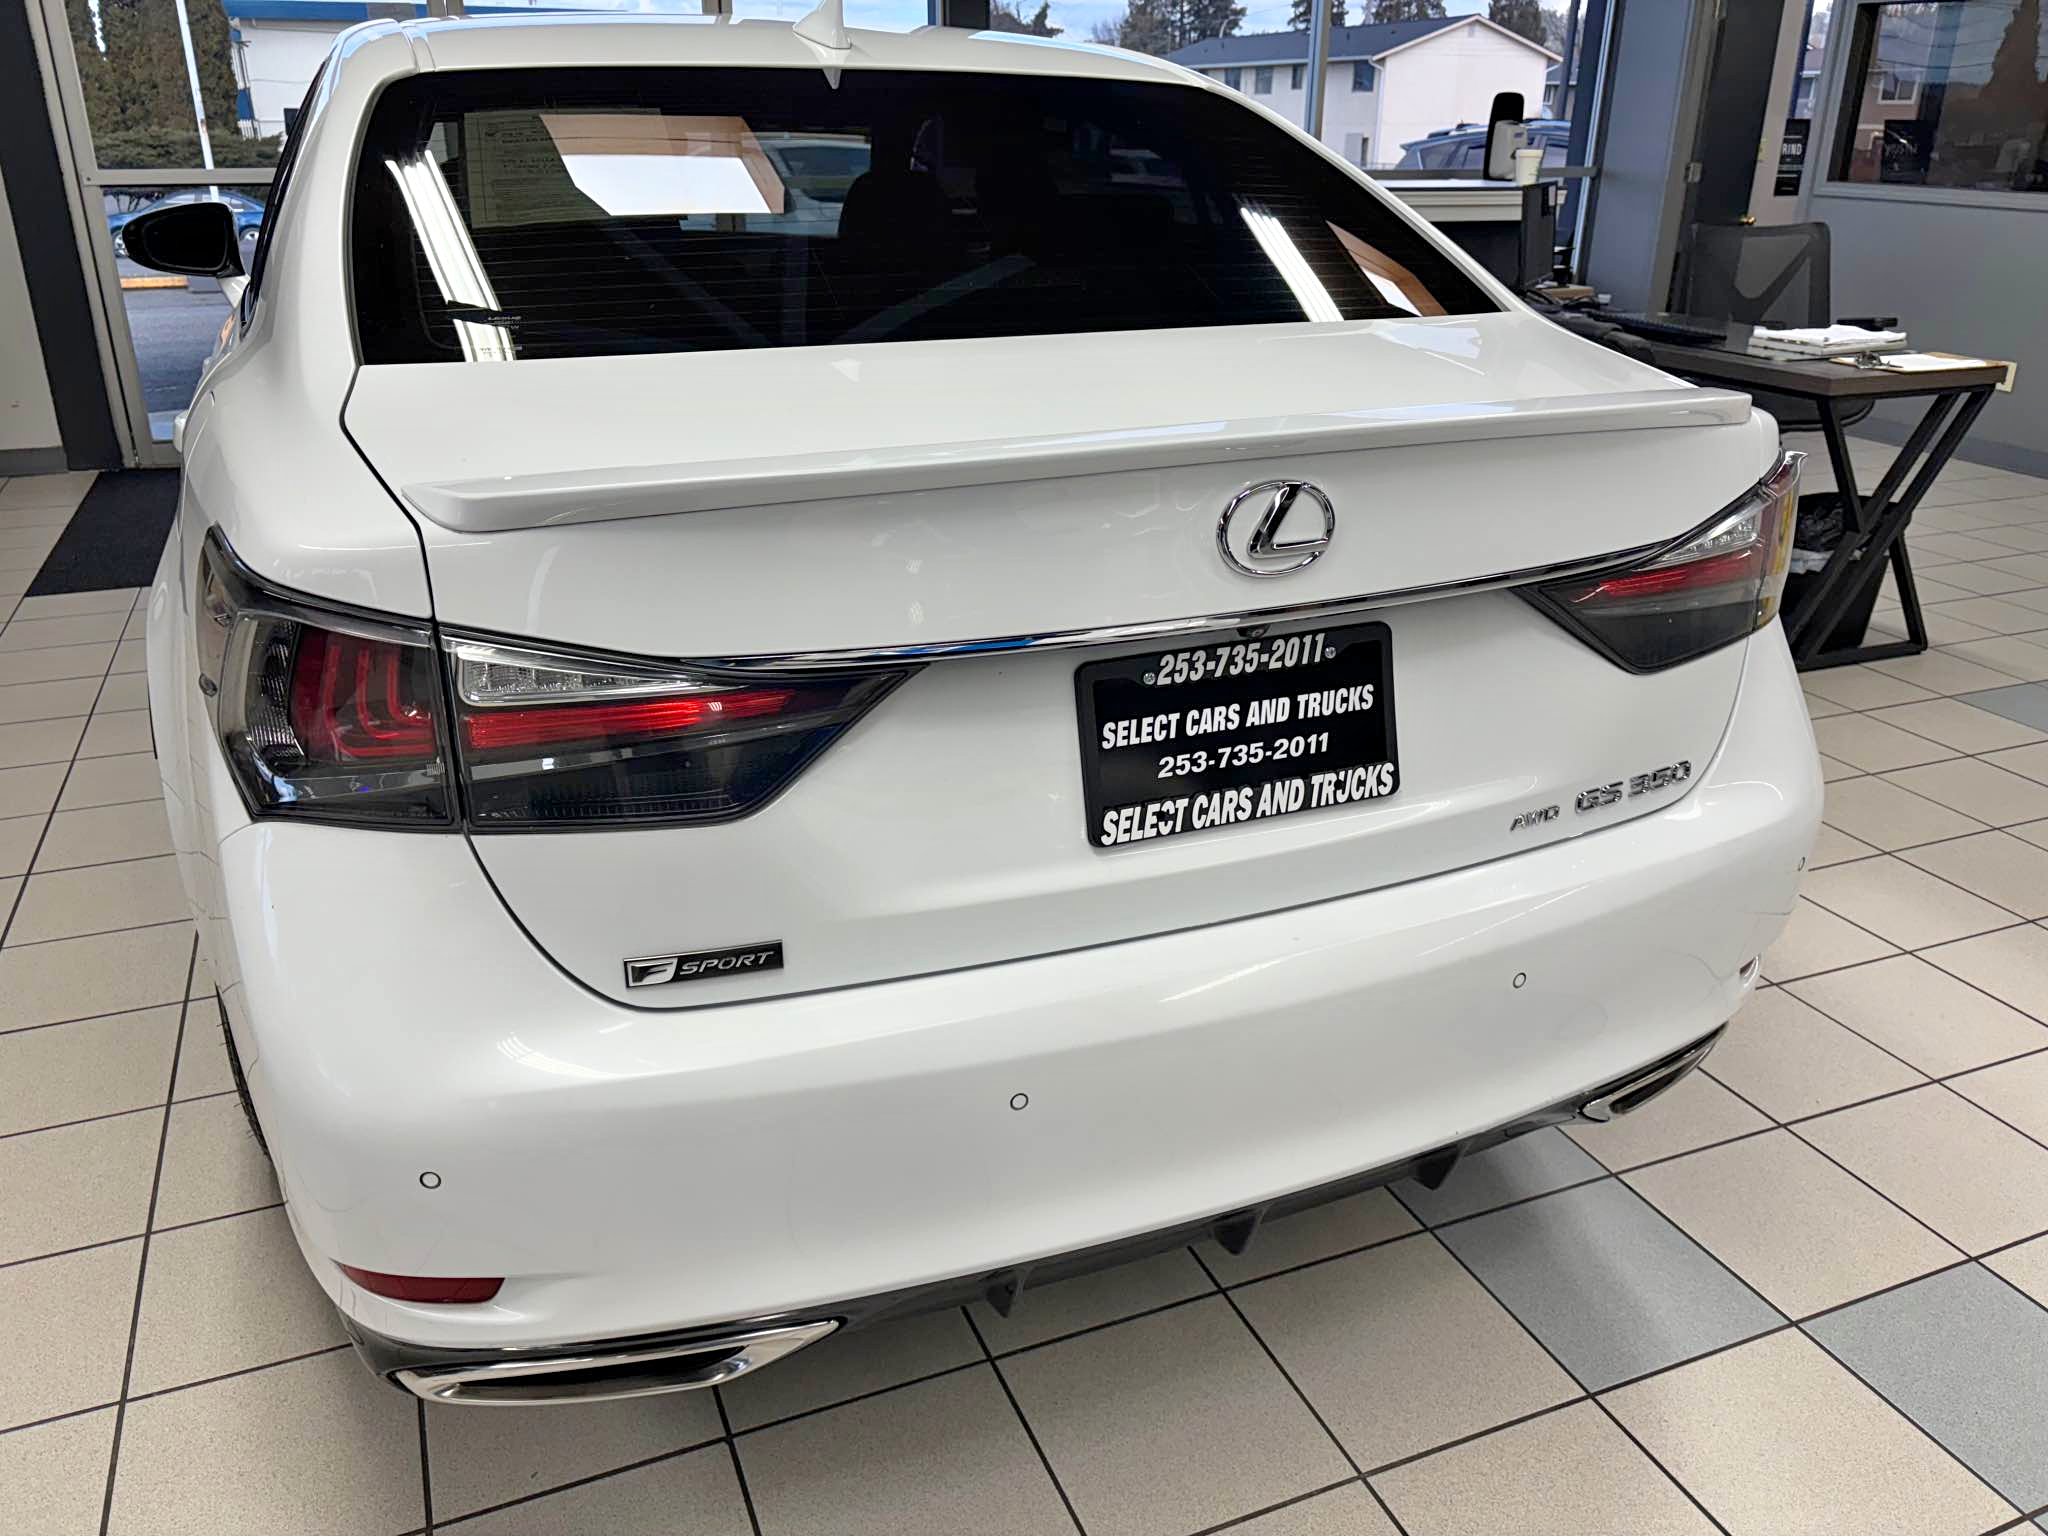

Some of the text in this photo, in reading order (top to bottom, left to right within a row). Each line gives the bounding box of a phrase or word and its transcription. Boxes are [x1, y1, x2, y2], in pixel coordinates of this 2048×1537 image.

[1156, 634, 1325, 685] 253-735-2011
[1101, 684, 1374, 750] SELECT CARS AND TRUCKS
[1158, 732, 1329, 778] 253-735-2011
[1101, 762, 1394, 846] SELECT CARS AND TRUCKS
[1574, 760, 1692, 814] GS 350
[1509, 805, 1561, 832] AWD
[680, 952, 774, 975] SPORT
